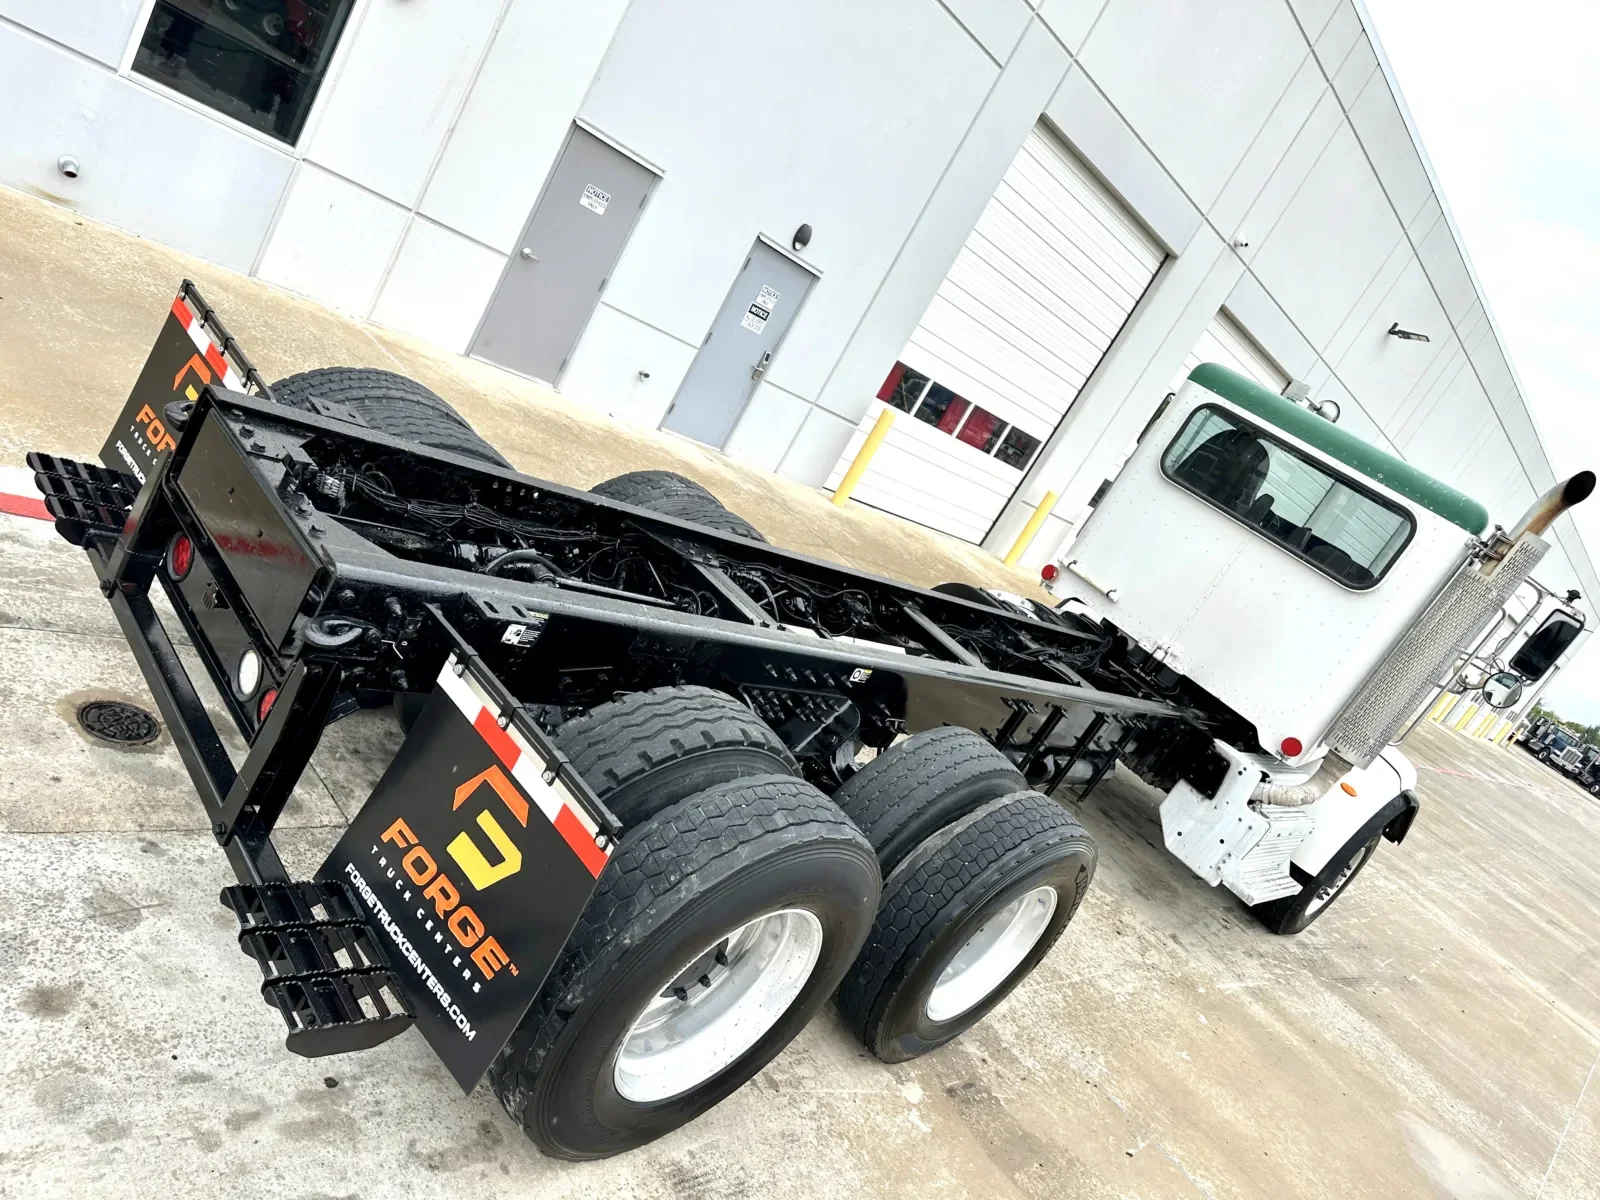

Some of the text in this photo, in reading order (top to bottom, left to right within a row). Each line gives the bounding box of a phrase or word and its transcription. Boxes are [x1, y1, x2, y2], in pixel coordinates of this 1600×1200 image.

[586, 185, 610, 203] NOTICE
[750, 304, 769, 320] NOTICE
[129, 425, 152, 457] TRUCK
[135, 403, 177, 453] FOR
[370, 844, 482, 994] TRUCK CENTERS
[380, 817, 511, 981] FORGE
[344, 862, 477, 1042] FORGETRUCKCENTERS.COM
